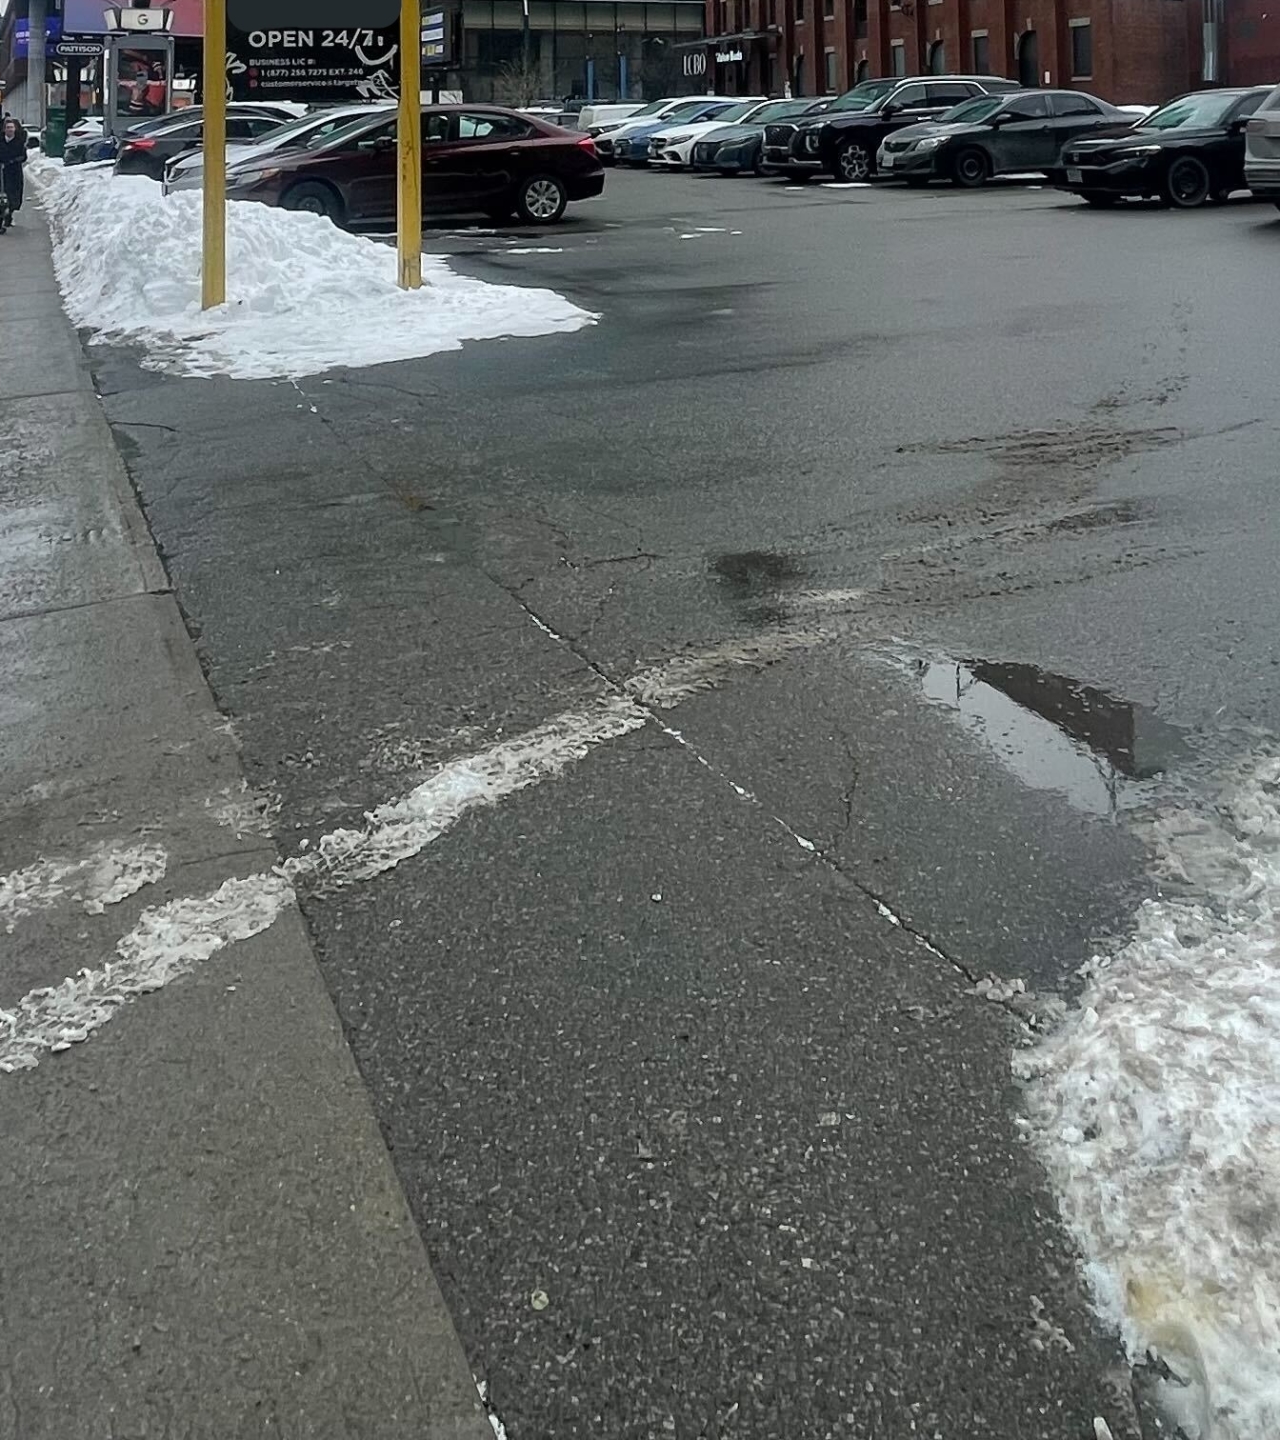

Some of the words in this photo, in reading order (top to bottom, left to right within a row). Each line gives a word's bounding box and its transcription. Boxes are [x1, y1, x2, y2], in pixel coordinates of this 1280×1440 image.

[248, 30, 314, 48] OPEN
[321, 28, 374, 49] 24/7
[60, 45, 100, 53] PATTISON
[249, 58, 291, 66] BUSINESS
[292, 58, 306, 66] LIC
[683, 52, 707, 77] LCBO
